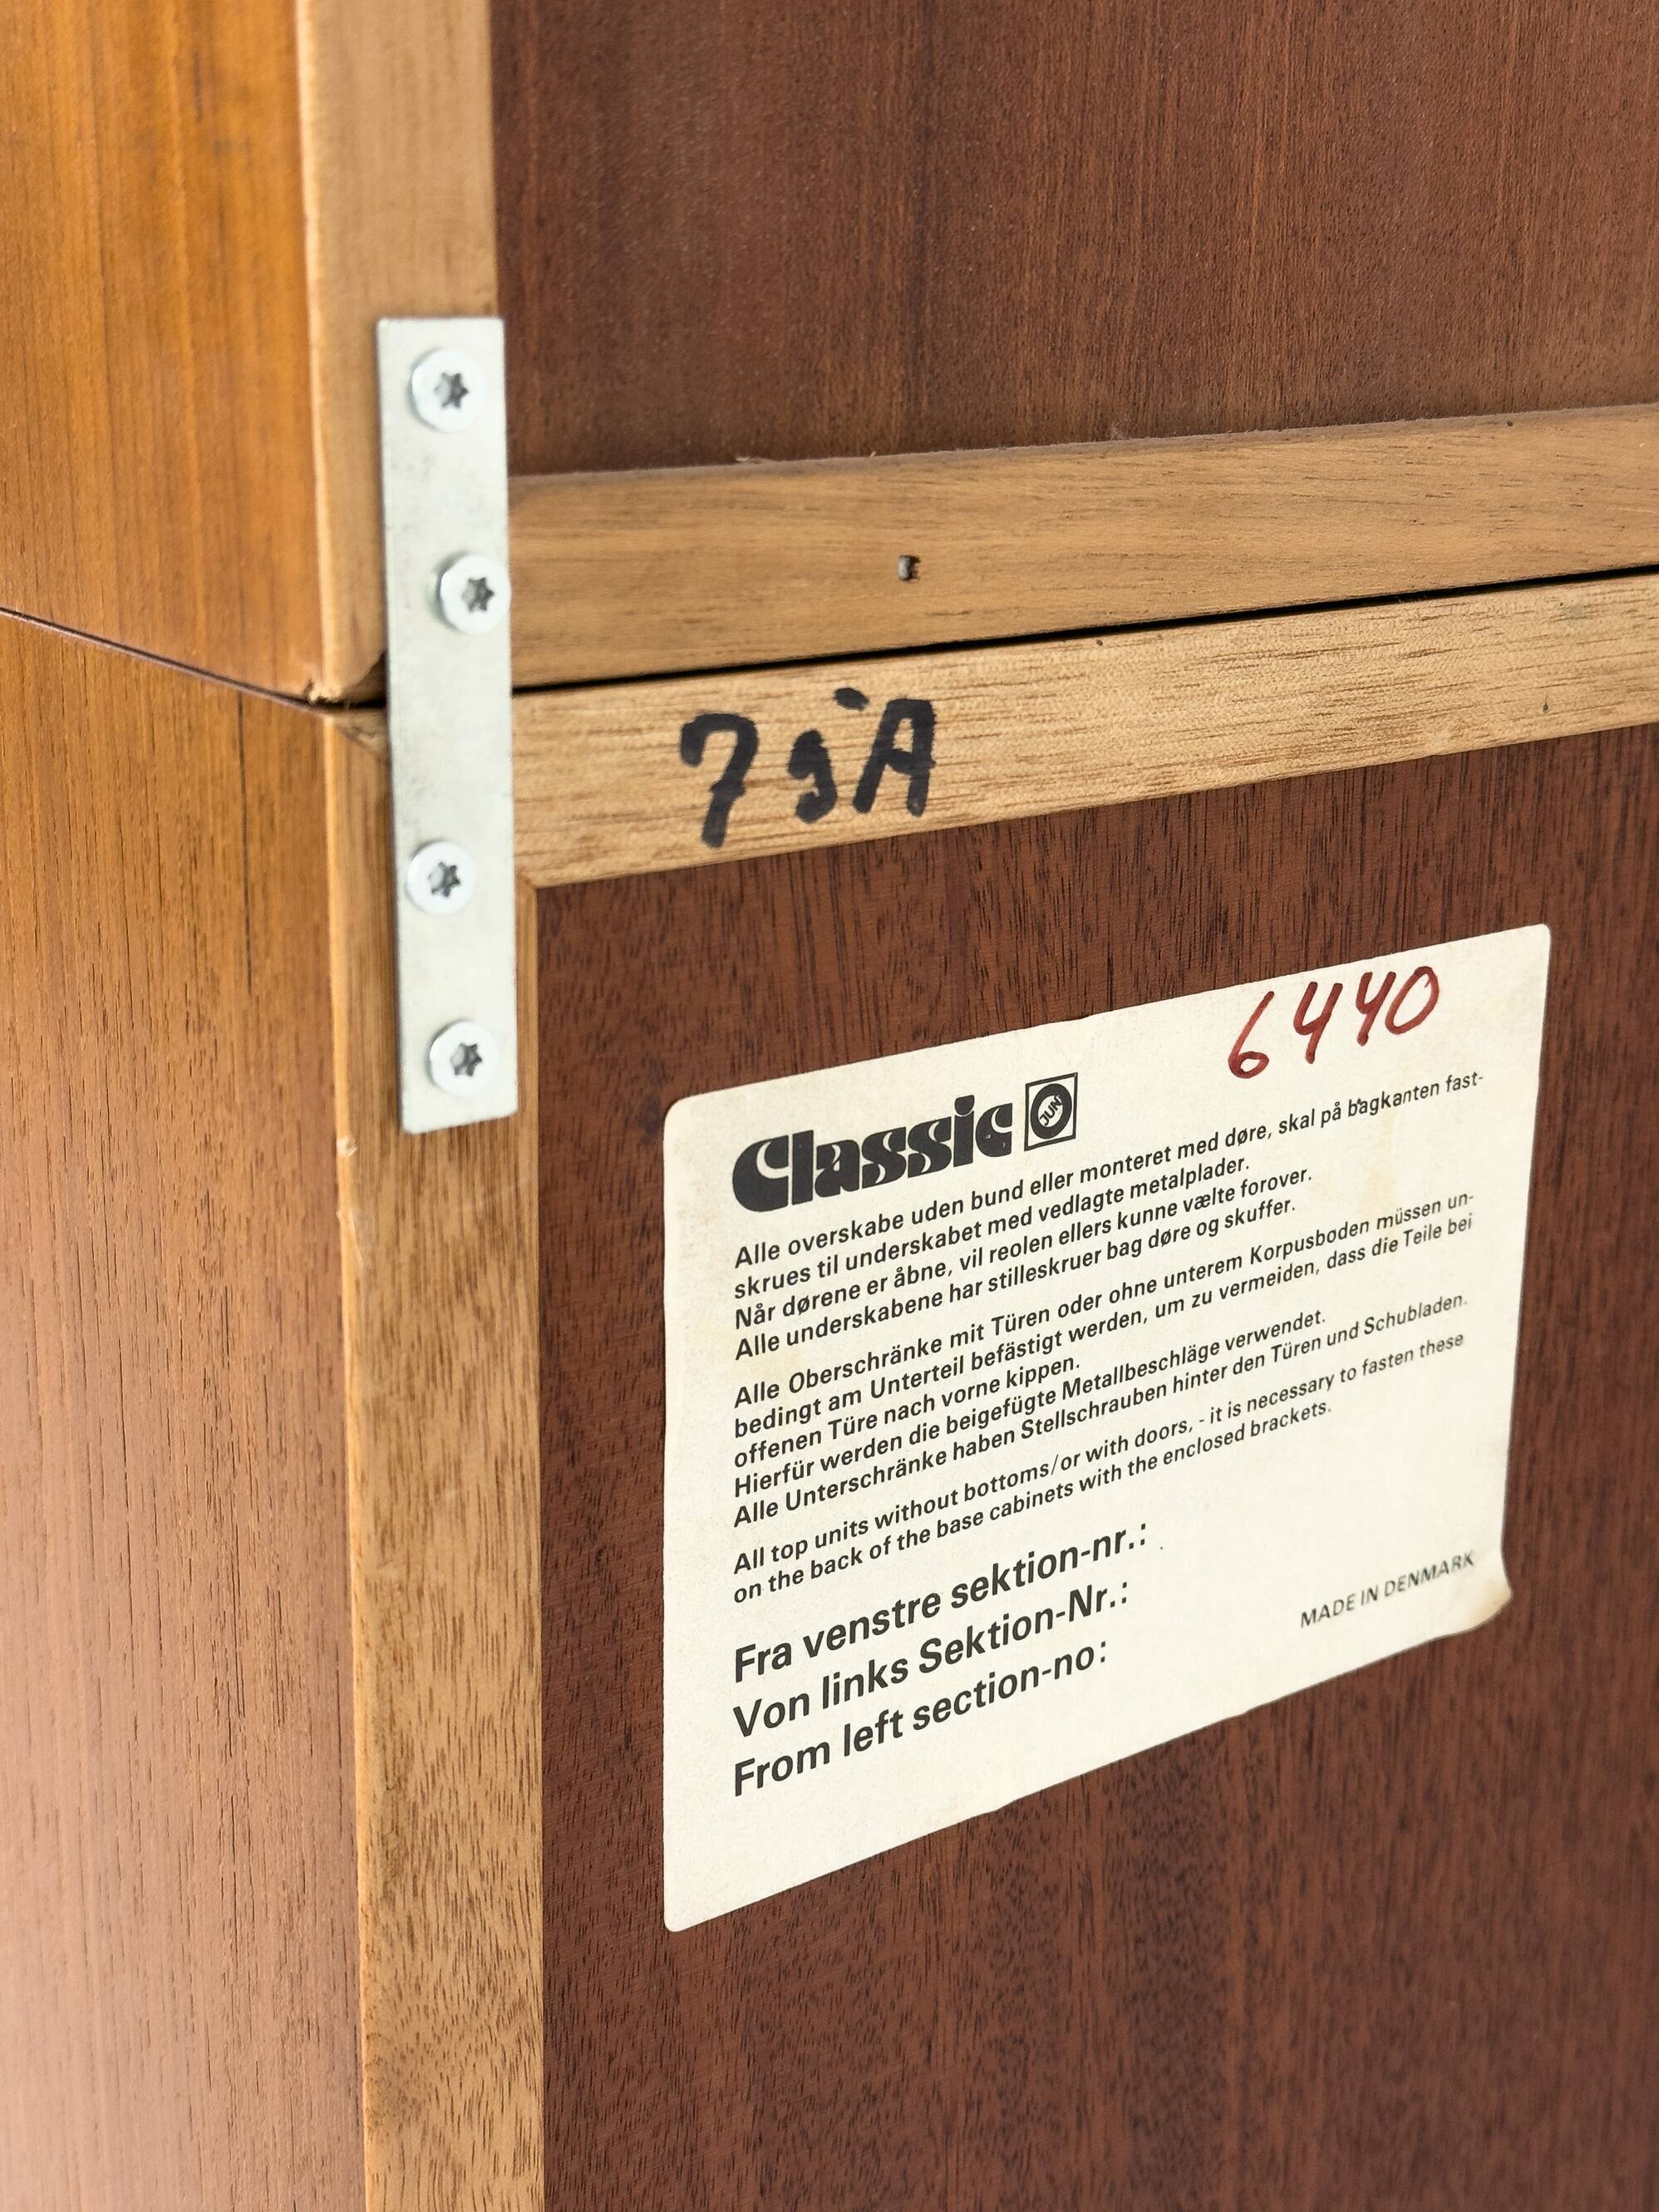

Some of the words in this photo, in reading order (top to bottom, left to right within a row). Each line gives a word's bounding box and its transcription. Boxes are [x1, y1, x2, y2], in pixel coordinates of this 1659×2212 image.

[1228, 965, 1440, 1079] 6440
[732, 1094, 1013, 1213] Classic
[734, 1241, 780, 1269] Alle
[787, 1213, 904, 1256] overskabe
[911, 1199, 964, 1225] uden
[971, 1178, 1024, 1211] bund
[1030, 1171, 1075, 1196] eller
[1080, 1145, 1172, 1184] monteret
[1177, 1131, 1219, 1160] med
[1224, 1125, 1273, 1148] døre,
[1277, 1107, 1316, 1135] skal
[1320, 1101, 1341, 1129] på
[1347, 1082, 1440, 1118] bagkanten
[1445, 1071, 1484, 1093] fast-
[734, 1266, 811, 1299] skrues
[816, 1254, 839, 1278] til
[845, 1220, 982, 1271] underskabet
[987, 1205, 1032, 1236] med
[1037, 1188, 1125, 1223] vedlagte
[1130, 1156, 1249, 1200] metalplader.
[734, 1381, 780, 1409] Alle
[789, 1338, 943, 1394] Oberschränke
[950, 1323, 985, 1349] mit
[990, 1308, 1050, 1337] Türen
[1057, 1293, 1103, 1318] oder
[1109, 1278, 1158, 1304] ohne
[1164, 1255, 1243, 1289] unterem
[1250, 1220, 1370, 1265] Korpusboden
[1376, 1200, 1441, 1230] müssen
[1447, 1193, 1474, 1210] un-
[735, 1302, 776, 1330] Når
[782, 1283, 861, 1318] dørene
[866, 1276, 889, 1296] er
[893, 1262, 953, 1288] åbne,
[958, 1246, 983, 1271] vil
[989, 1234, 1053, 1264] reolen
[1058, 1219, 1112, 1246] ellers
[1117, 1202, 1178, 1230] kunne
[1182, 1186, 1236, 1213] vælte
[1240, 1168, 1312, 1198] forover.
[735, 1332, 780, 1362] Alle
[786, 1291, 943, 1347] underskabene
[949, 1280, 983, 1303] har
[987, 1249, 1102, 1293] stilleskruer
[1106, 1238, 1143, 1261] bag
[1148, 1225, 1191, 1249] døre
[1196, 1218, 1219, 1238] og
[1223, 1198, 1296, 1229] skuffer.
[735, 1397, 822, 1439] bedingt
[828, 1389, 862, 1412] am
[870, 1354, 964, 1399] Unterteil
[971, 1329, 1063, 1372] befästigt
[1067, 1310, 1148, 1343] werden,
[1154, 1298, 1185, 1318] um
[1191, 1290, 1213, 1309] zu
[1218, 1262, 1320, 1300] vermeiden,
[1327, 1247, 1366, 1269] dass
[1371, 1236, 1399, 1257] die
[1402, 1223, 1443, 1248] Teile
[1447, 1212, 1473, 1235] bei
[733, 1499, 779, 1529] Alle
[785, 1450, 948, 1511] Unterschränke
[953, 1429, 1016, 1461] haben
[1021, 1383, 1167, 1440] Stellschrauben
[1173, 1365, 1228, 1394] hinter
[1232, 1354, 1265, 1376] den
[1270, 1337, 1322, 1363] Türen
[1327, 1320, 1360, 1347] und
[1363, 1295, 1467, 1335] Schubladen.
[733, 1545, 765, 1575] All
[770, 1539, 809, 1563] top
[815, 1520, 869, 1549] units
[874, 1489, 959, 1530] without
[1085, 1435, 1129, 1463] with
[1134, 1420, 1194, 1448] doors,
[1210, 1406, 1223, 1425] it
[1227, 1400, 1242, 1419] is
[1247, 1373, 1335, 1413] necessary
[1339, 1367, 1357, 1383] to
[1361, 1349, 1414, 1377] fasten
[1419, 1333, 1464, 1358] these
[734, 1430, 822, 1468] offenen
[827, 1414, 879, 1441] Türe
[884, 1392, 935, 1425] nach
[941, 1378, 1001, 1407] vorne
[1006, 1357, 1081, 1389] kippen.
[735, 1459, 815, 1498] Hierfür
[820, 1436, 903, 1472] werden
[908, 1421, 940, 1446] die
[946, 1390, 1056, 1435] beigefügte
[1061, 1342, 1220, 1401] Metallbeschläge
[1224, 1309, 1326, 1352] verwendet.
[733, 1583, 762, 1604] on
[767, 1569, 805, 1593] the
[810, 1546, 864, 1580] back
[869, 1535, 892, 1560] of
[896, 1528, 931, 1551] the
[937, 1511, 984, 1539] base
[989, 1482, 1074, 1521] cabinets
[1078, 1463, 1122, 1492] with
[1127, 1456, 1158, 1477] the
[1163, 1422, 1245, 1466] enclosed
[1250, 1402, 1332, 1437] brackets.
[732, 1692, 810, 1738] Von
[822, 1658, 909, 1710] links
[918, 1581, 1128, 1674] Sektion-Nr.:
[735, 1642, 792, 1683] Fra
[802, 1592, 942, 1659] venstre
[950, 1523, 1146, 1609] sektion-nr.:
[1300, 1593, 1356, 1628] MADE
[1361, 1585, 1379, 1606] IN
[1384, 1553, 1474, 1598] DENMARK
[734, 1741, 830, 1797] From
[844, 1708, 904, 1757] left
[912, 1640, 1106, 1731] section-no:
